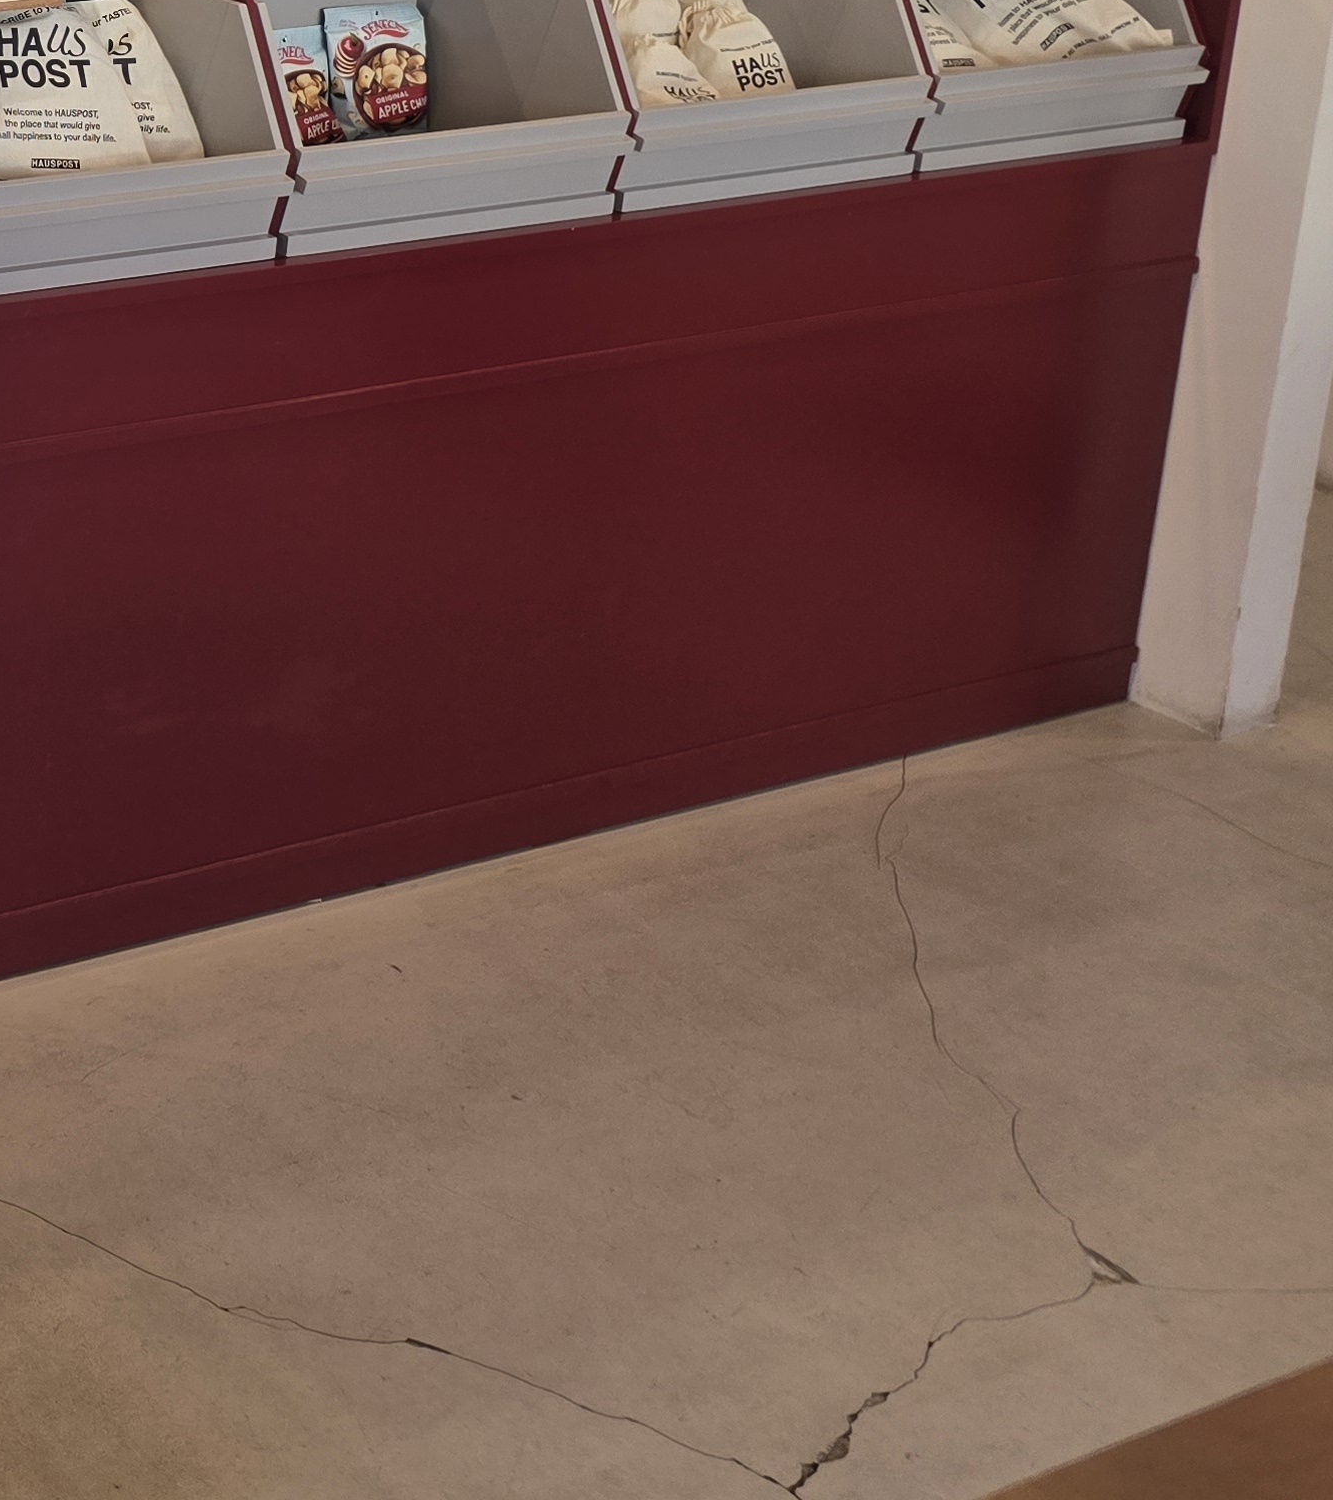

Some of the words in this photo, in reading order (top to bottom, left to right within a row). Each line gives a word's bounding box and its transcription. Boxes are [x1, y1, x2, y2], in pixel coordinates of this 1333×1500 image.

[361, 19, 410, 40] SENECA
[732, 52, 781, 76] HAUS
[736, 68, 786, 92] POST
[376, 90, 409, 104] ORIGINAL
[3, 107, 43, 117] Welcome
[44, 108, 53, 117] to
[54, 108, 99, 119] HAUSPOST,
[379, 101, 409, 119] APPLE
[4, 119, 18, 128] the
[20, 119, 42, 130] place
[43, 120, 59, 129] that
[60, 120, 83, 130] would
[84, 121, 101, 132] give
[137, 114, 155, 124] give
[155, 124, 171, 134] life.
[307, 120, 330, 140] APPLE
[12, 131, 53, 142] happiness
[54, 133, 62, 141] to
[63, 134, 81, 143] your
[82, 133, 101, 143] daily
[102, 133, 117, 143] life.
[32, 159, 80, 169] HAUSPOST
